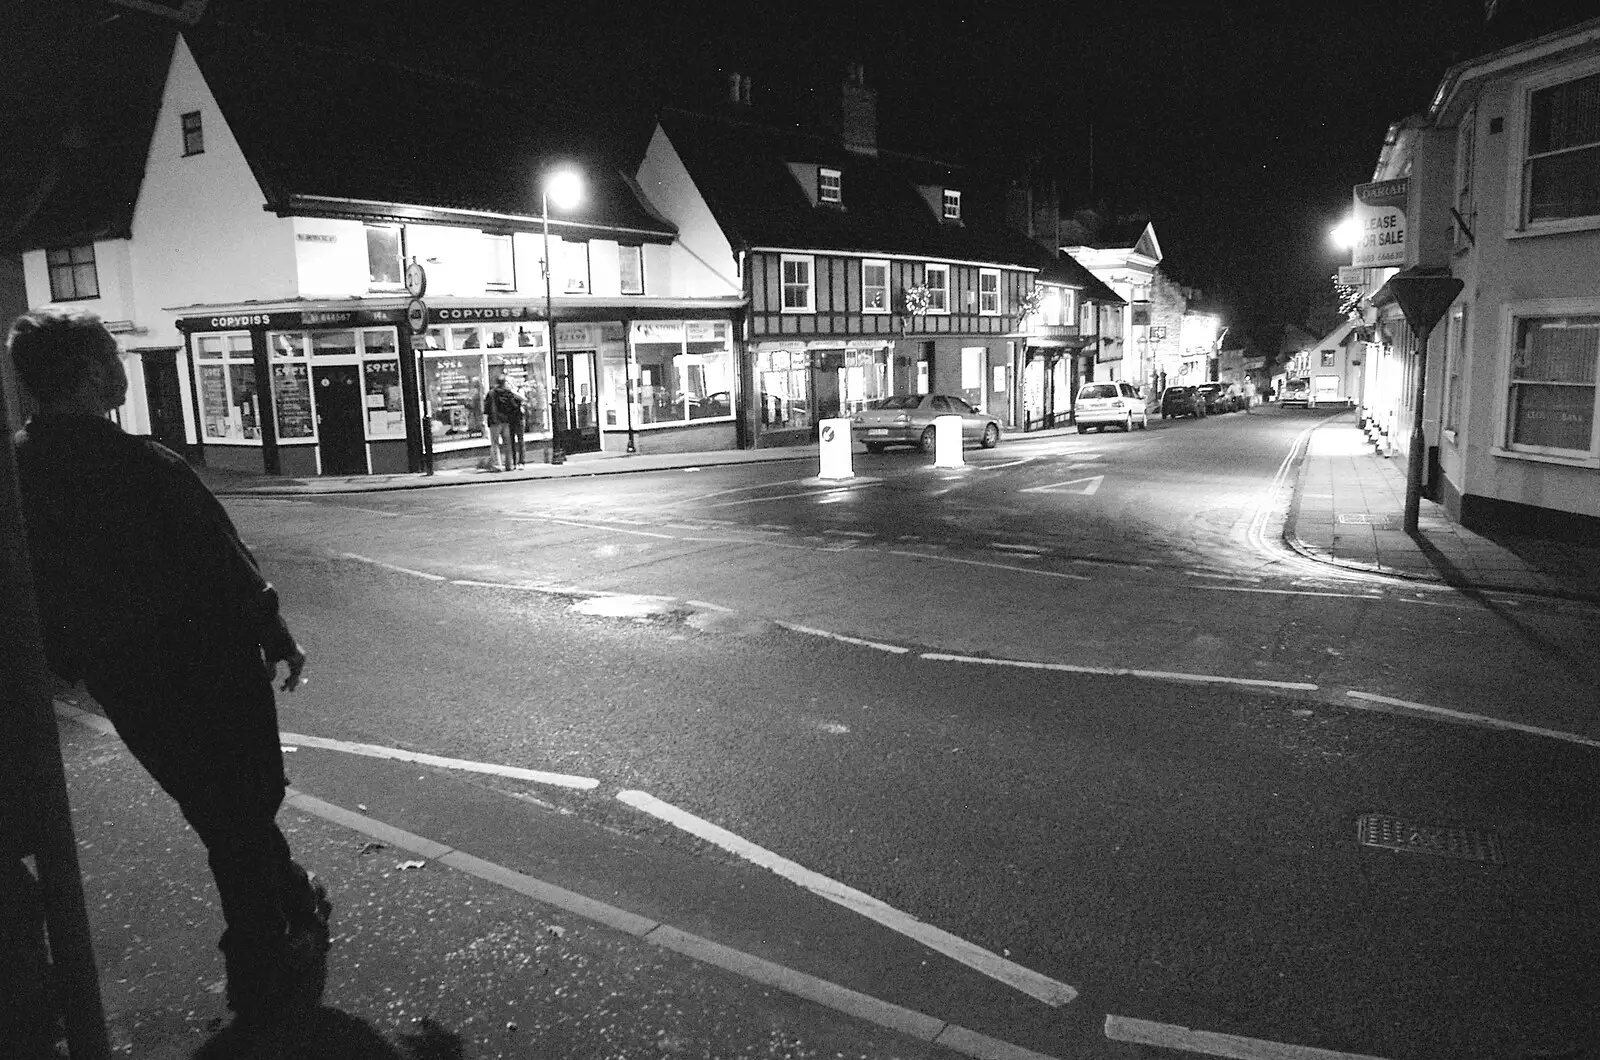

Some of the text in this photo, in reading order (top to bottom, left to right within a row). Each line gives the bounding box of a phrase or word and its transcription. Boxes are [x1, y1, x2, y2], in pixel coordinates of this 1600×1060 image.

[1364, 215, 1397, 230] LEASE
[1379, 230, 1404, 245] SALE
[211, 314, 270, 327] COPYDISS
[439, 308, 522, 319] COPYDISS
